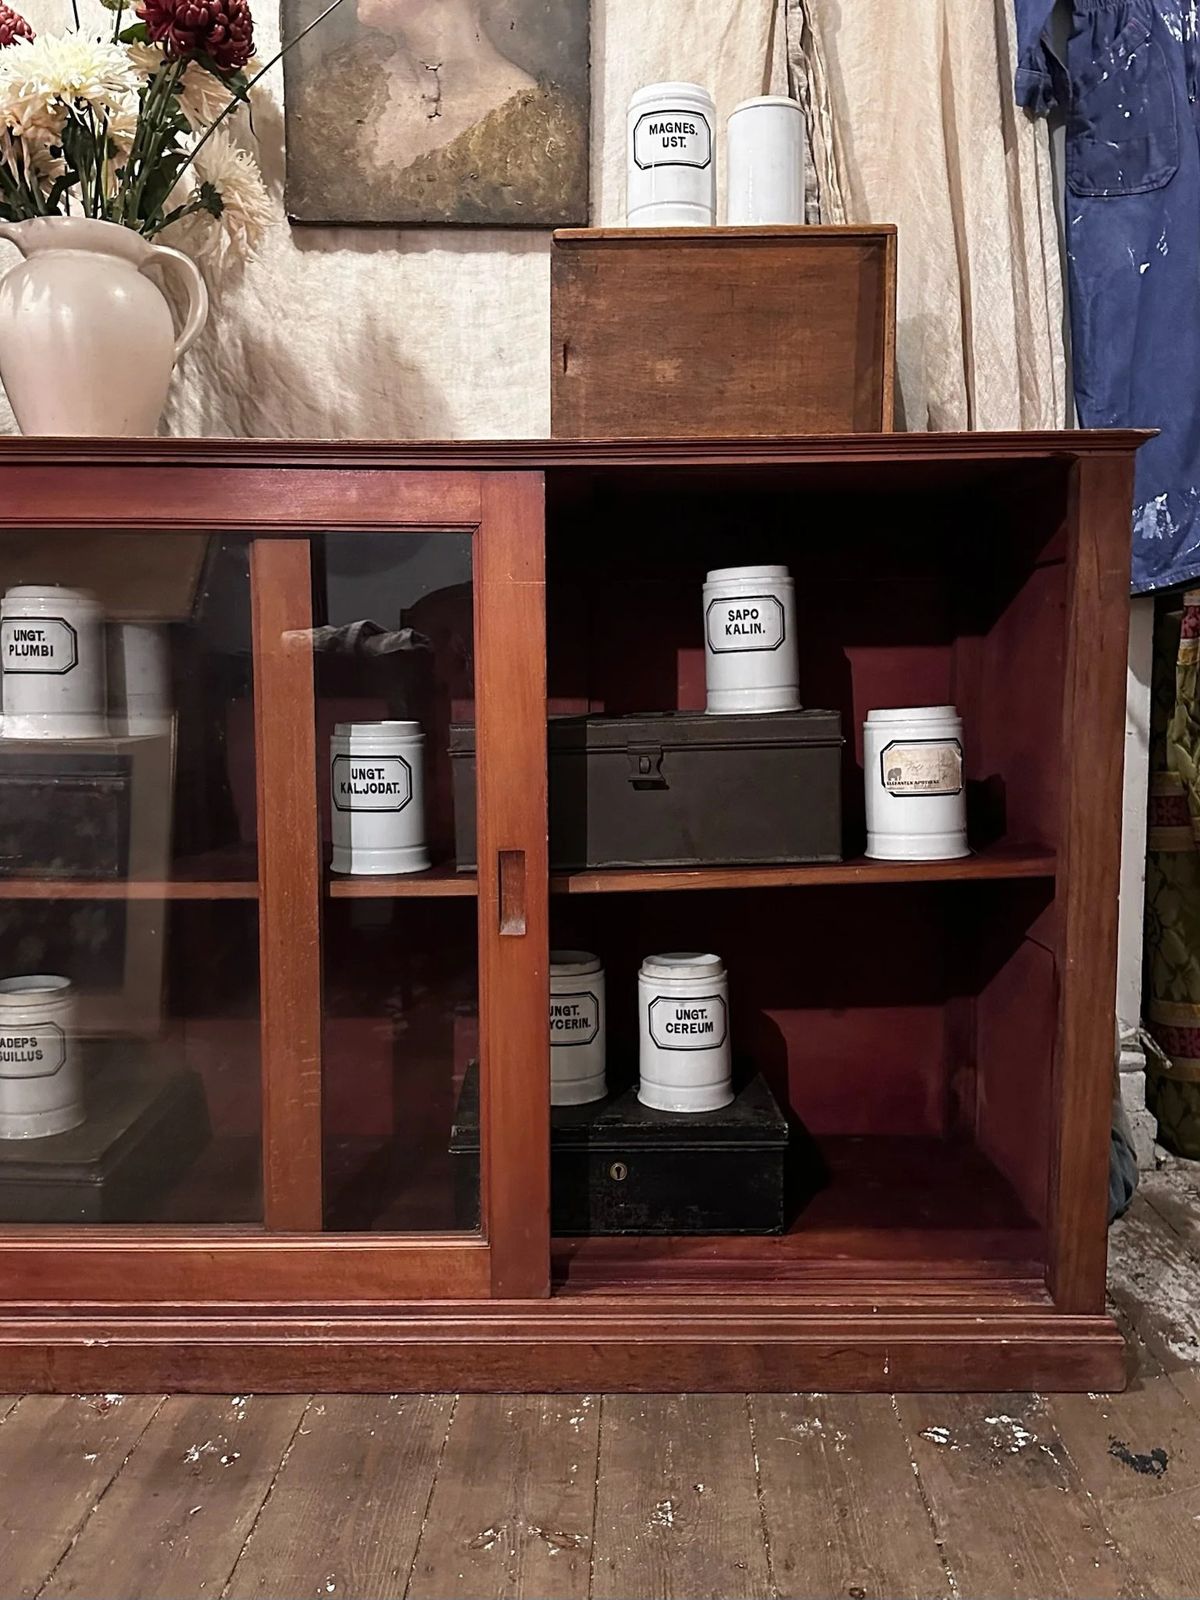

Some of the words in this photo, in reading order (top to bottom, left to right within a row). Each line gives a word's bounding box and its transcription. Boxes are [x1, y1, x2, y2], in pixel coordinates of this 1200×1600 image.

[649, 122, 698, 136] MAGNES.
[662, 136, 687, 148] UST.
[728, 608, 759, 621] SAPO
[725, 622, 766, 635] KALIN.
[14, 629, 46, 642] UNGT.
[9, 644, 54, 657] PLUMBI
[351, 768, 385, 780] UNGT.
[676, 1009, 708, 1020] UNGT.
[665, 1022, 714, 1034] CEREUM
[0, 1037, 38, 1048] ADEPS
